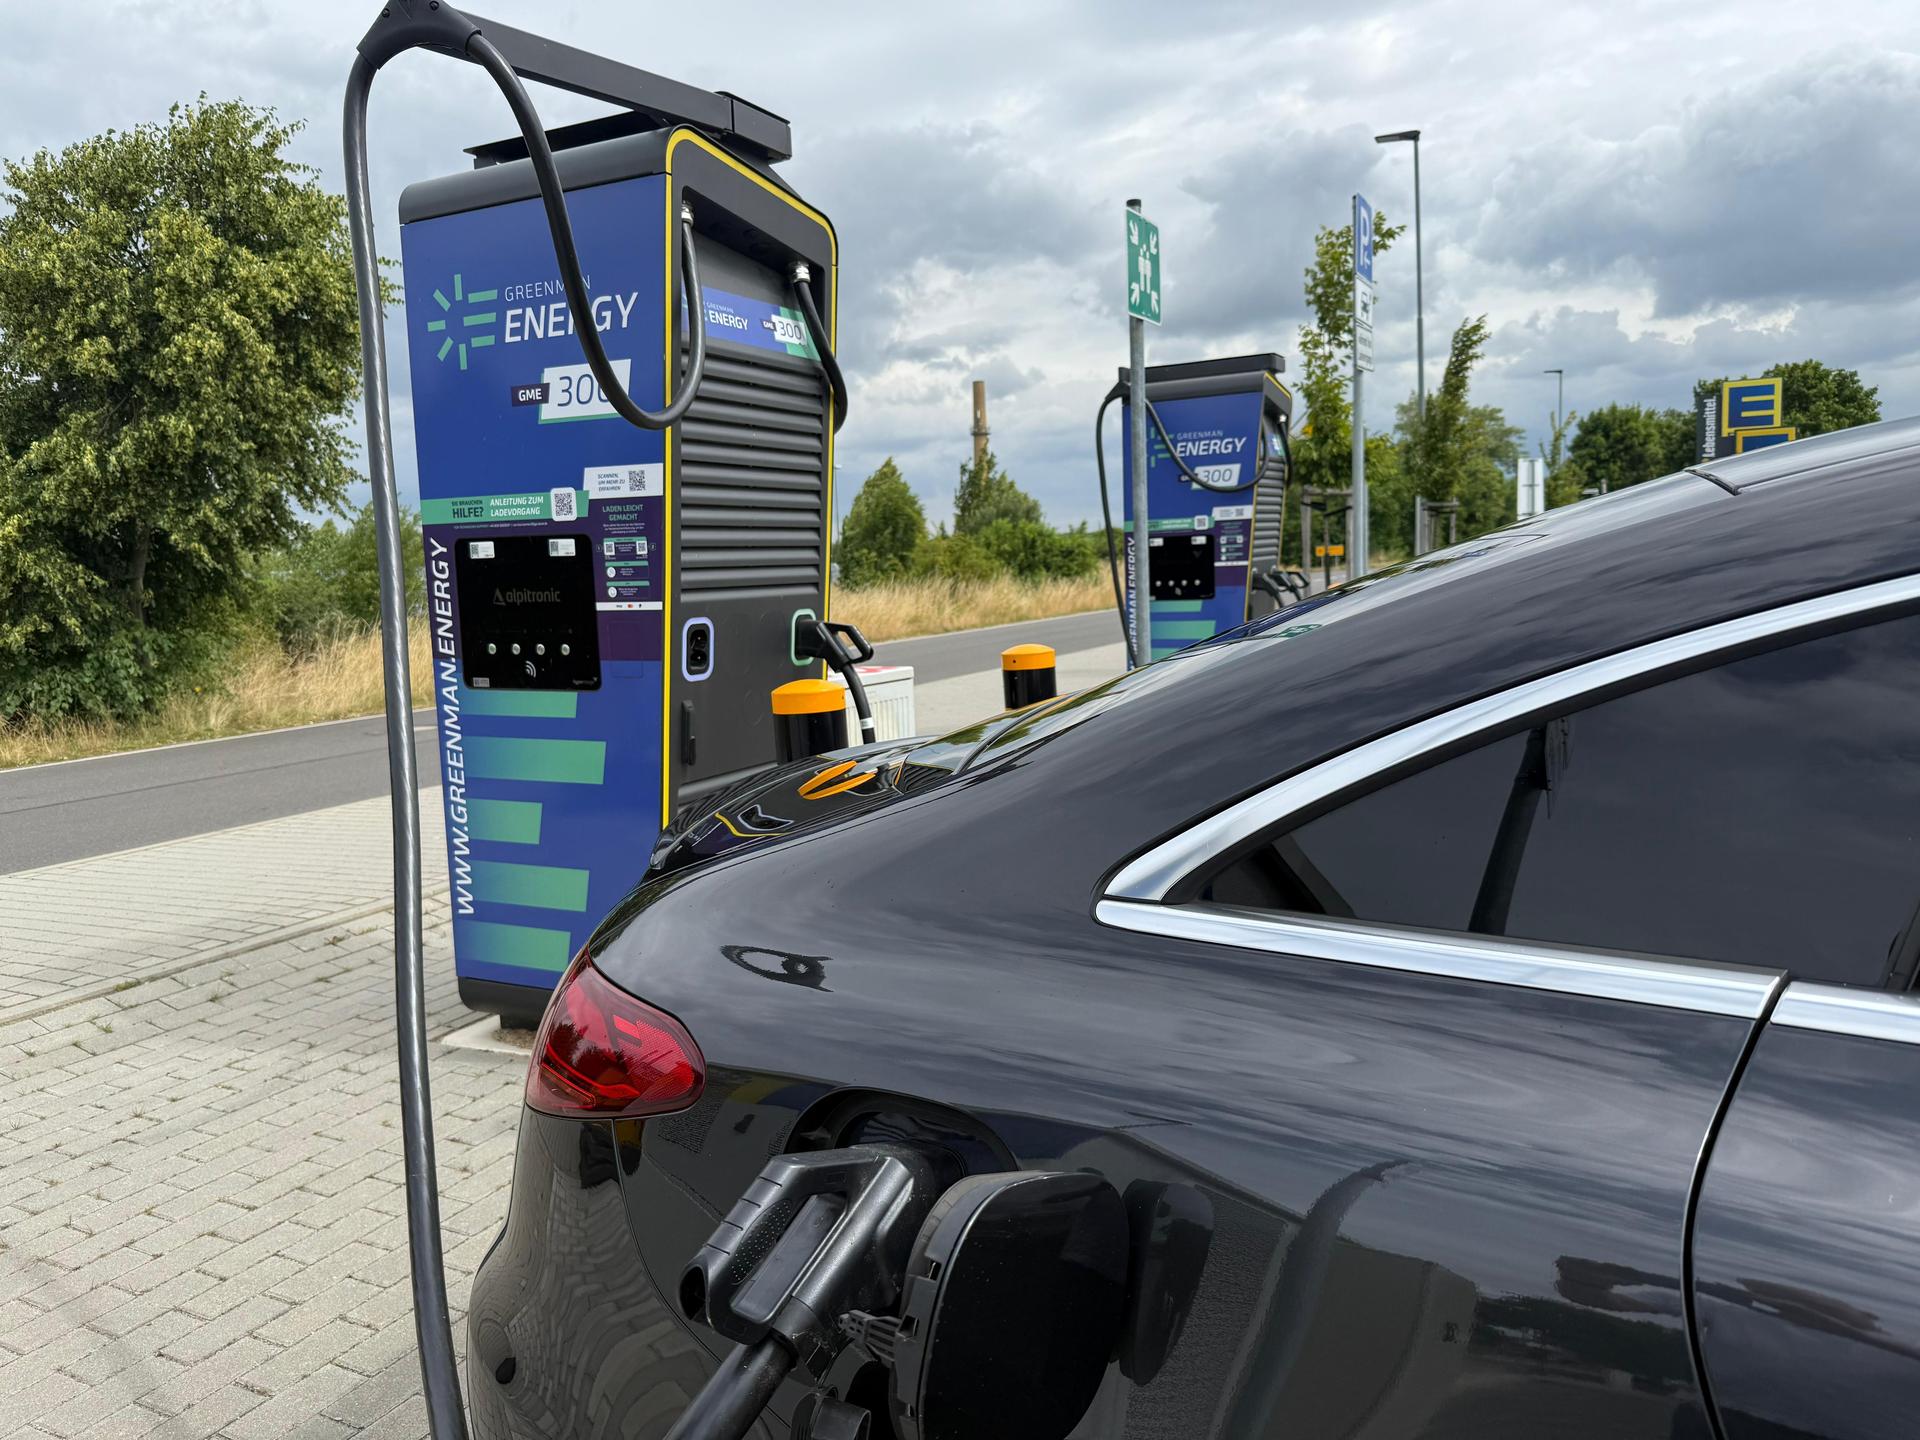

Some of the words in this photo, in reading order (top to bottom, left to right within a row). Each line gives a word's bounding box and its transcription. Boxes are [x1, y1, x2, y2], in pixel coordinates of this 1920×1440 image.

[1360, 206, 1370, 267] P
[504, 274, 592, 302] GREENMN
[708, 310, 749, 331] ENERGY
[779, 320, 802, 340] 300
[518, 388, 543, 402] GME
[1176, 430, 1223, 441] GREENMAN
[1176, 436, 1247, 457] ENERGY
[490, 497, 527, 507] ANLEITUNG
[528, 496, 544, 504] ZUM
[602, 504, 622, 513] LADEN
[623, 503, 644, 512] LEICHT
[452, 506, 484, 519] HILFE?
[490, 507, 540, 517] LADEVORGANG
[608, 513, 638, 521] GEMACHT
[505, 587, 561, 605] alpitronic
[431, 536, 475, 915] WWW.GREENMAN.ENERGY
